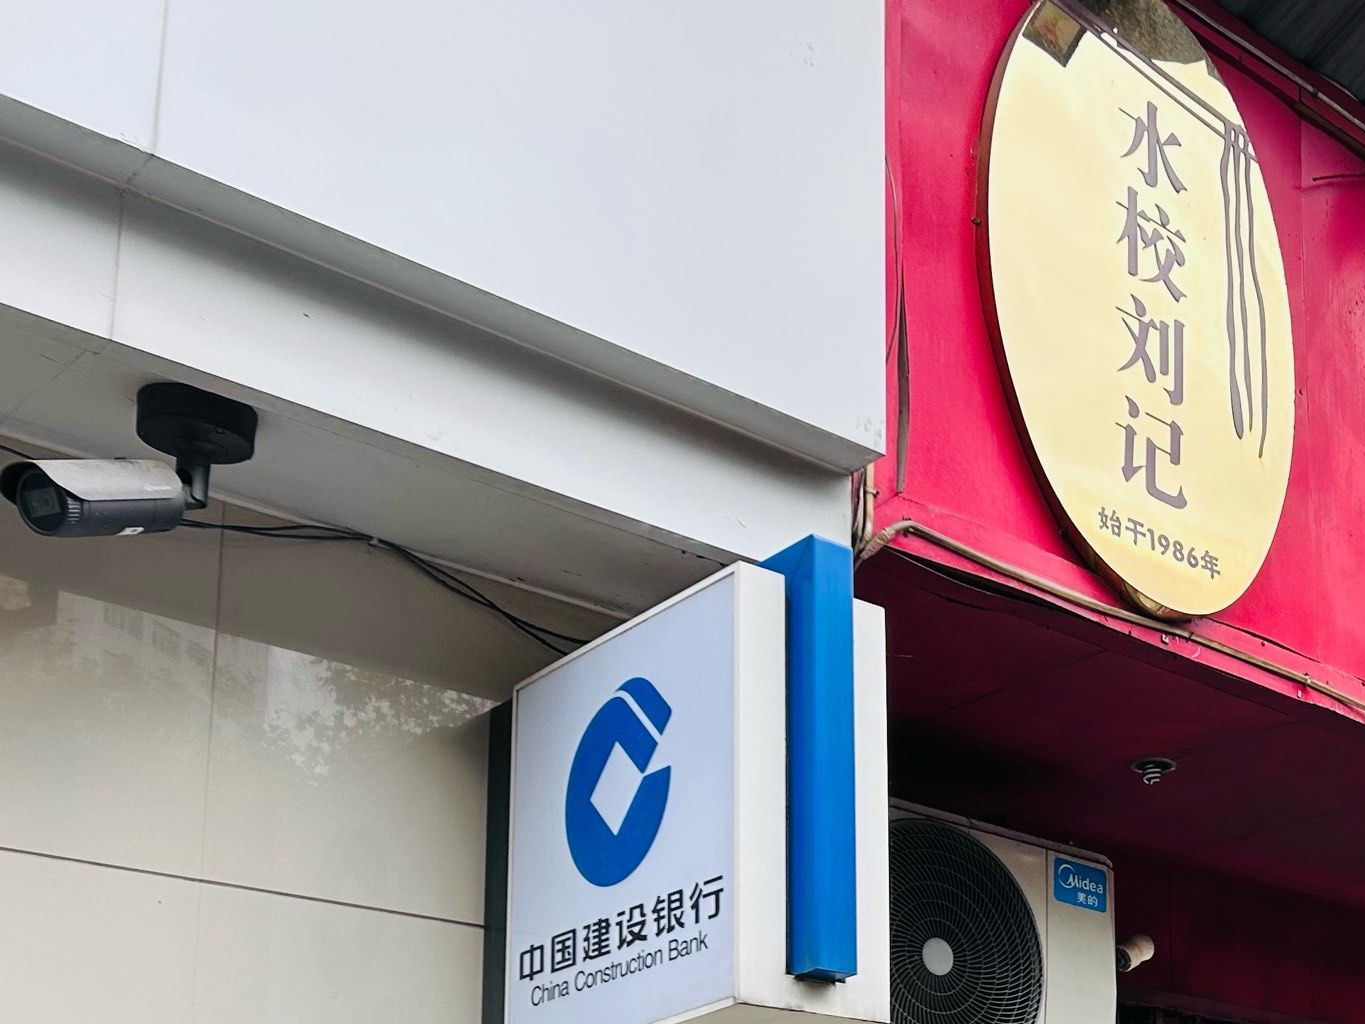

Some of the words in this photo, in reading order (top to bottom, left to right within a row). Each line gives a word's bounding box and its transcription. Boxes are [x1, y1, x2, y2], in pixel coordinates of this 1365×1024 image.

[1115, 101, 1187, 509] 水校刘记
[1058, 863, 1104, 894] Midea
[1076, 891, 1098, 907] 美的
[519, 875, 724, 981] 中国建设银行
[531, 980, 570, 1006] China
[574, 948, 663, 992] Construction
[668, 930, 709, 961] Bank
